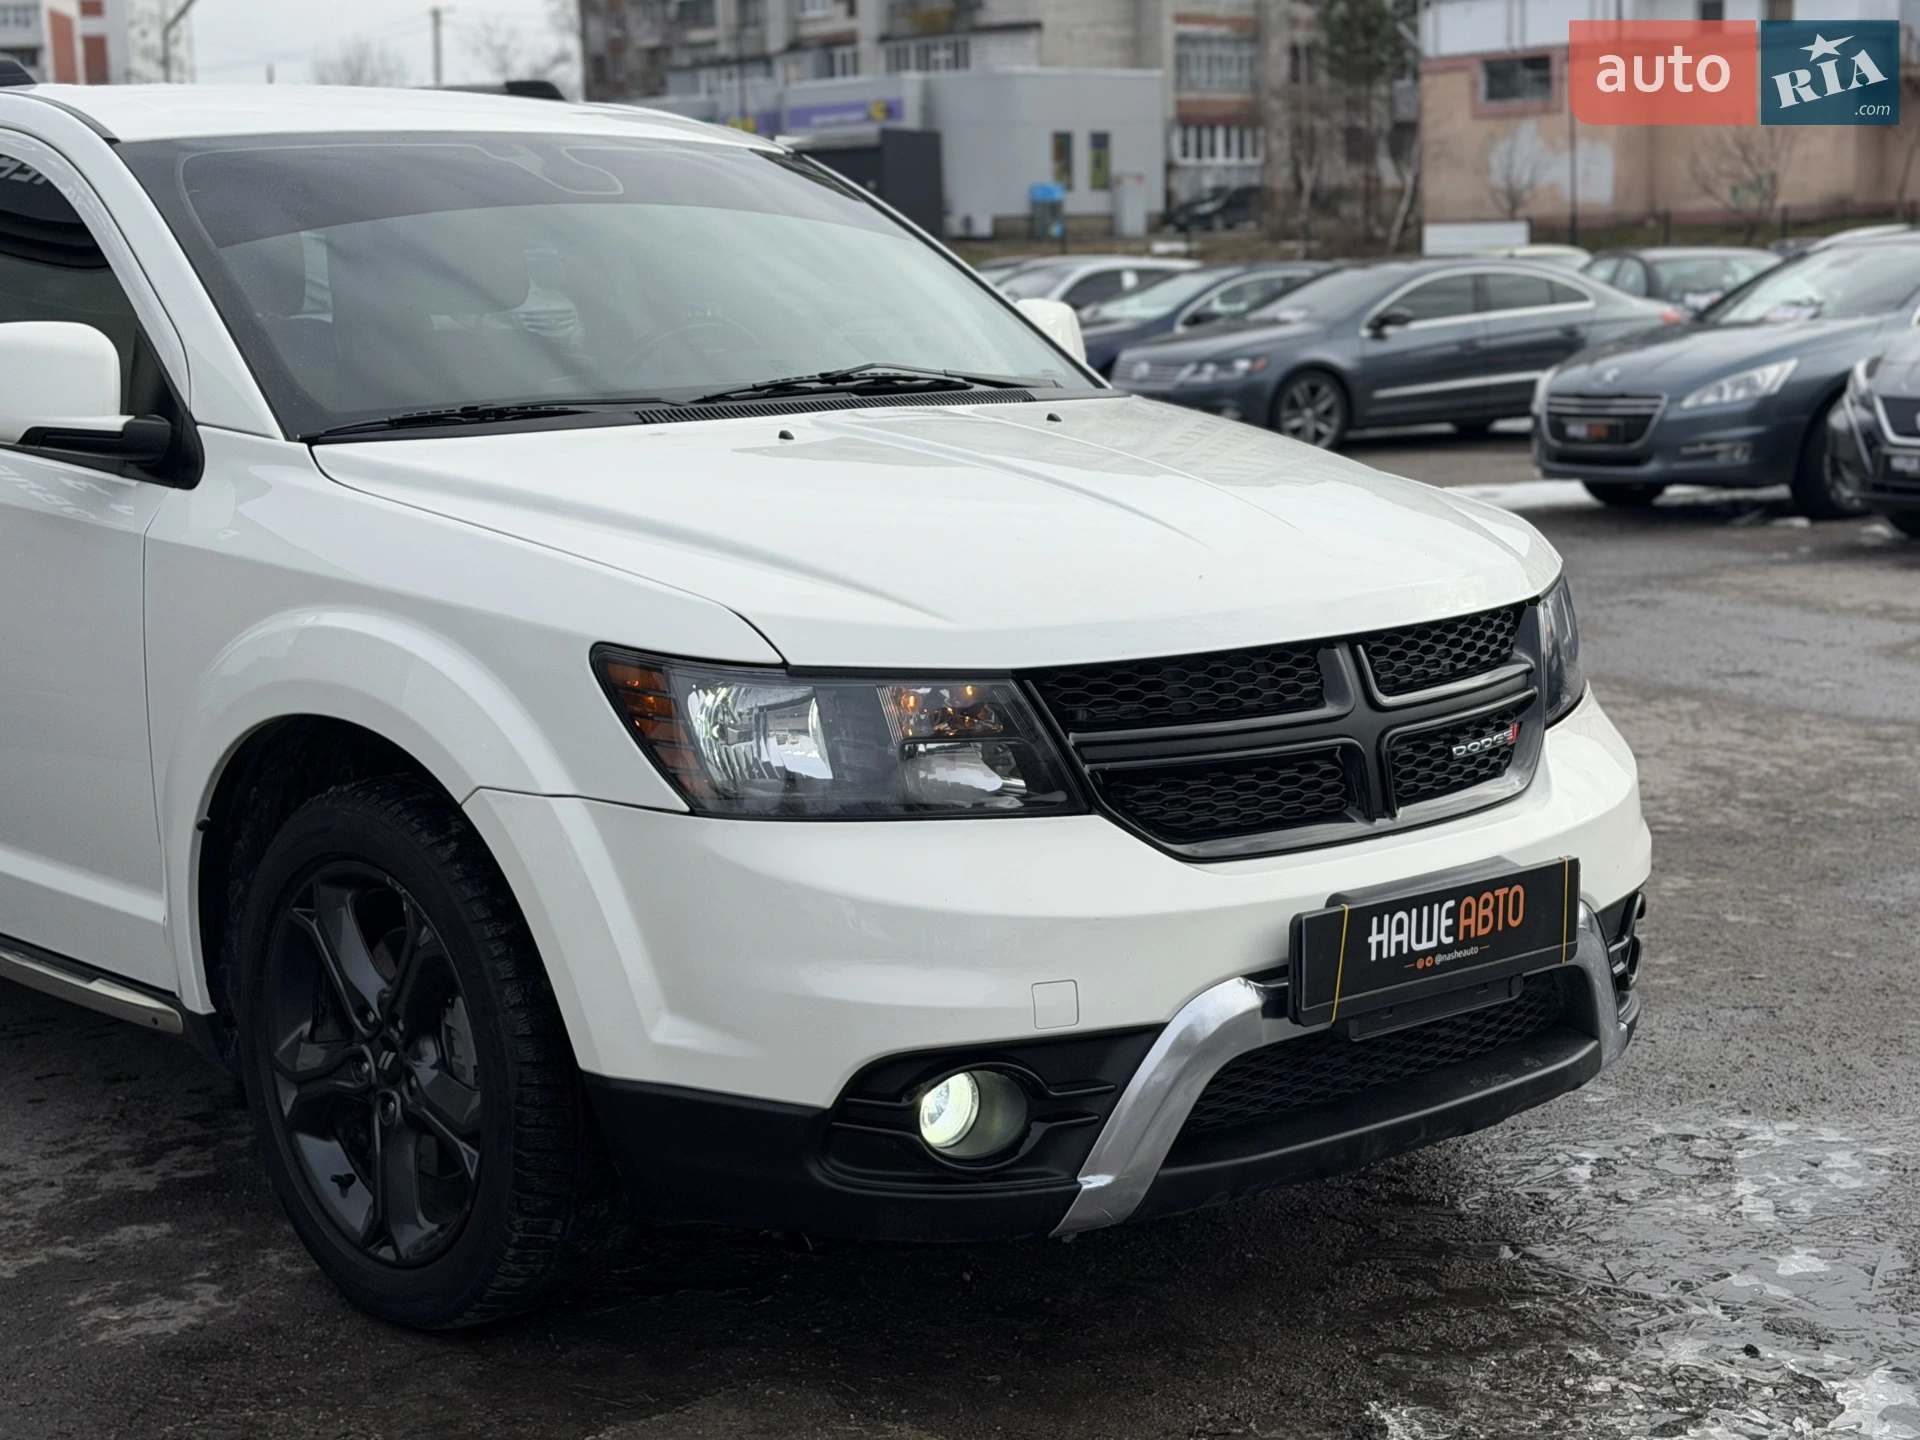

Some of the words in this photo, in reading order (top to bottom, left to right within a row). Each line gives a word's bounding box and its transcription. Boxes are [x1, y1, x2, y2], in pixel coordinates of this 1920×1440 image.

[1452, 729, 1514, 757] DODGE
[1367, 899, 1455, 962] НАШЕ
[1458, 884, 1525, 941] АВТО
[1434, 946, 1479, 965] @nasheauto
